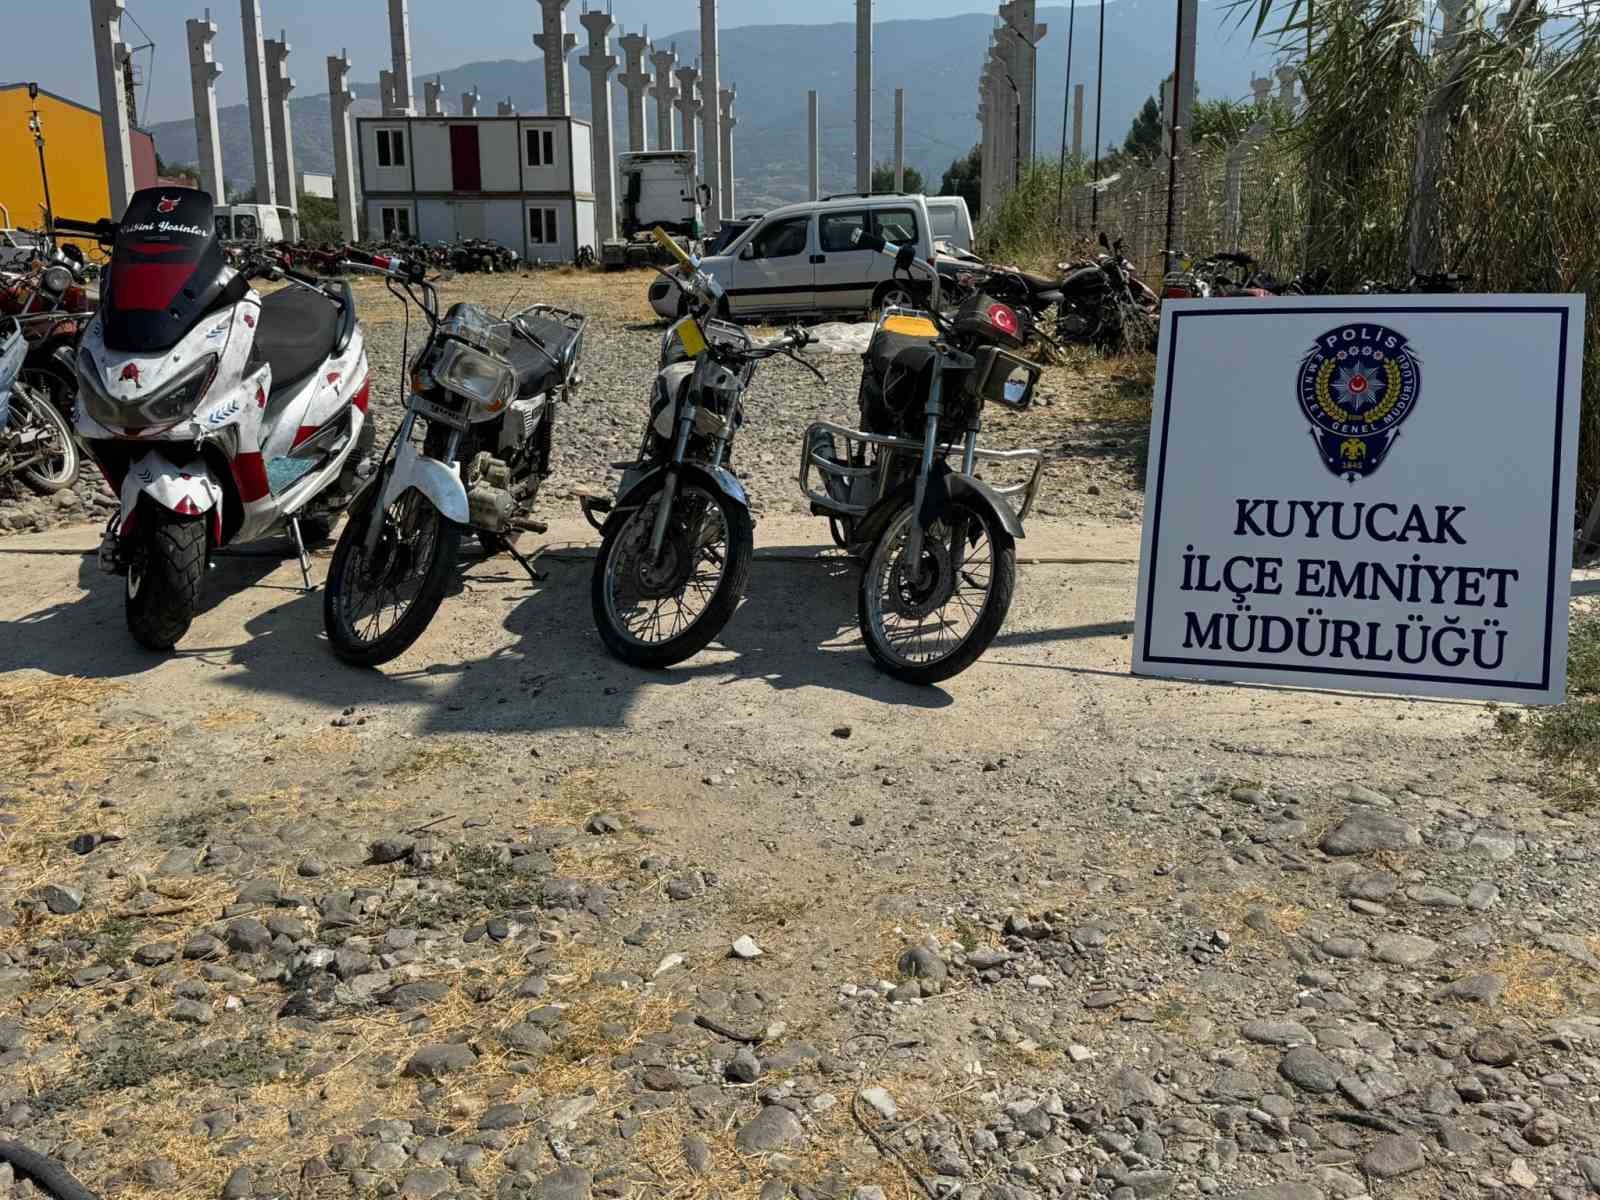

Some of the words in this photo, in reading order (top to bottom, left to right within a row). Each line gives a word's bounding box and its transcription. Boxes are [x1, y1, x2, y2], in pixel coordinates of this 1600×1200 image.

[1326, 327, 1398, 348] POLİS
[1332, 422, 1378, 433] GENEL
[1233, 498, 1466, 545] KUYUCAK
[1180, 543, 1283, 604] İLÇE
[1294, 553, 1519, 608] EMNİYET
[1182, 604, 1508, 670] MÜDÜRLÜĞÜ
